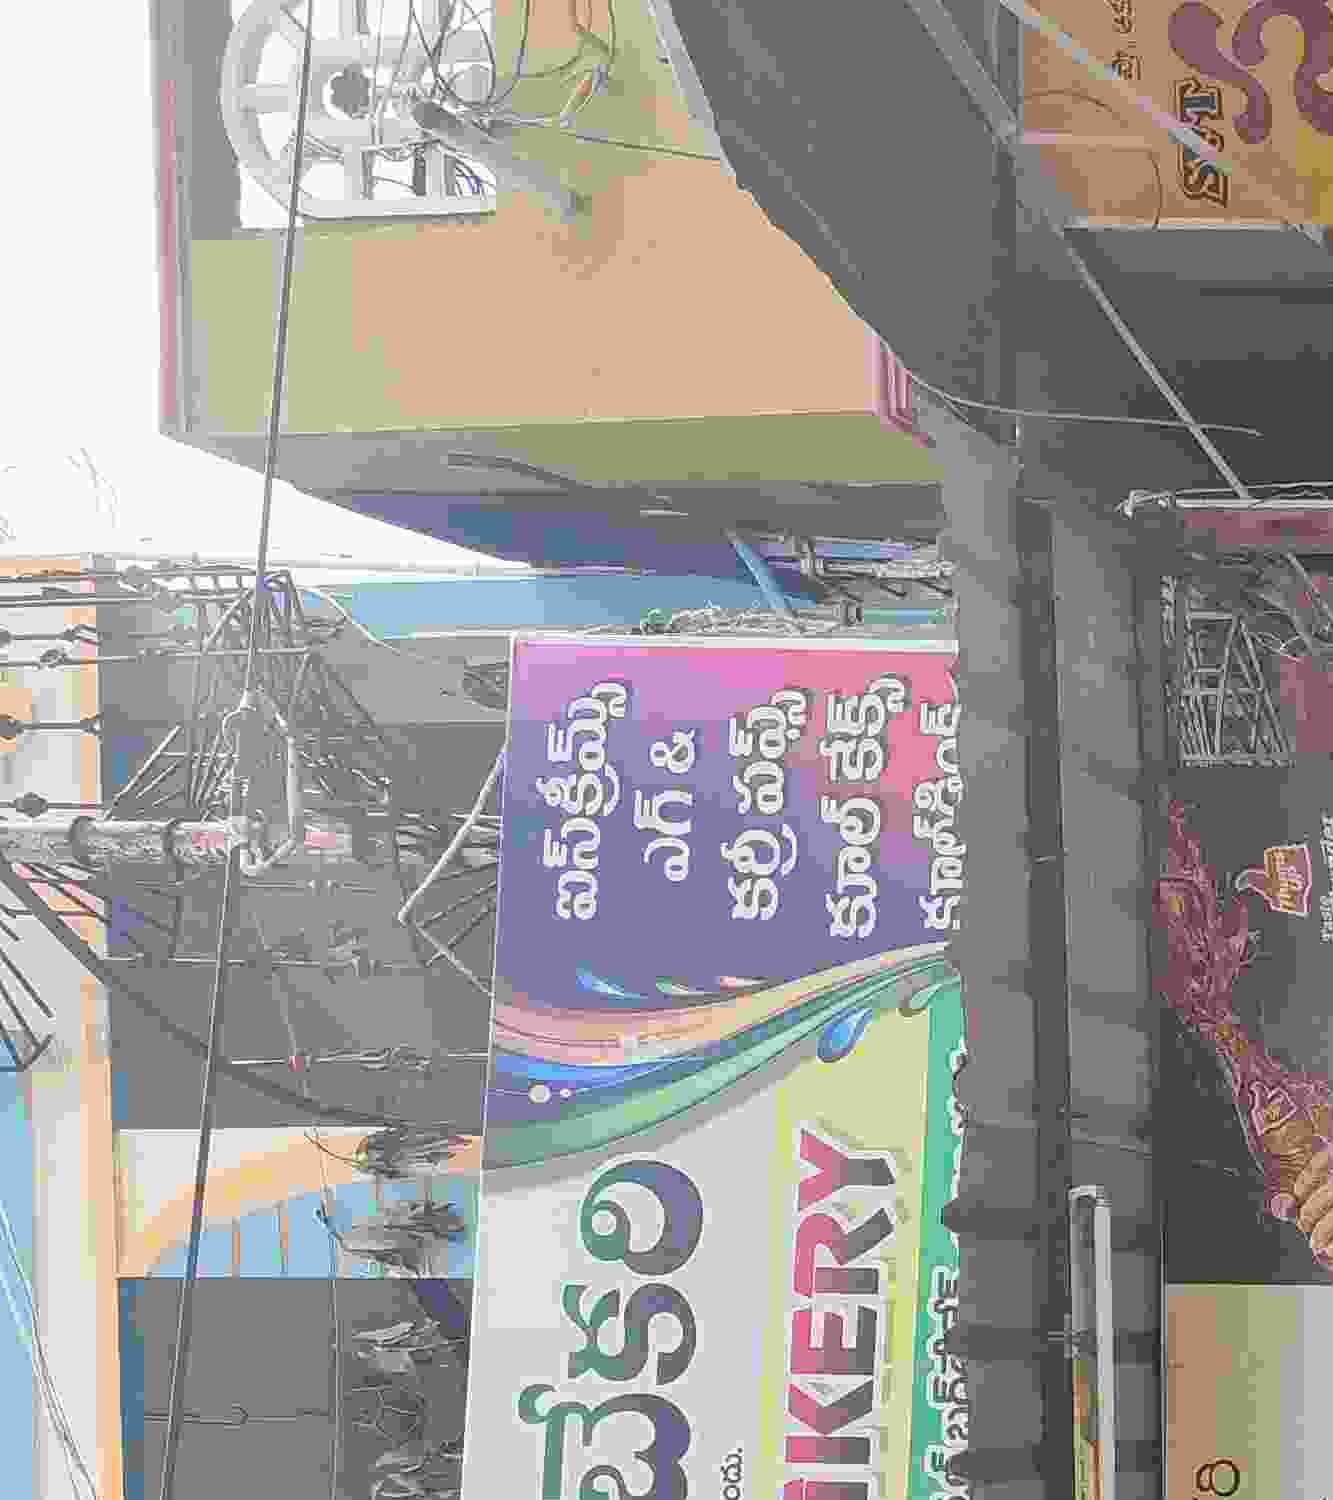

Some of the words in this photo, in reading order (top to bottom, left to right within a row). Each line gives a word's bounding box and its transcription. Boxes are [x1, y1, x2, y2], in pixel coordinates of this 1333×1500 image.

[648, 728, 695, 774] &
[818, 672, 906, 783] కేక్స్
[633, 789, 693, 882] ఎగ్
[720, 823, 798, 920] కర్రీ
[818, 796, 880, 938] కూల్
